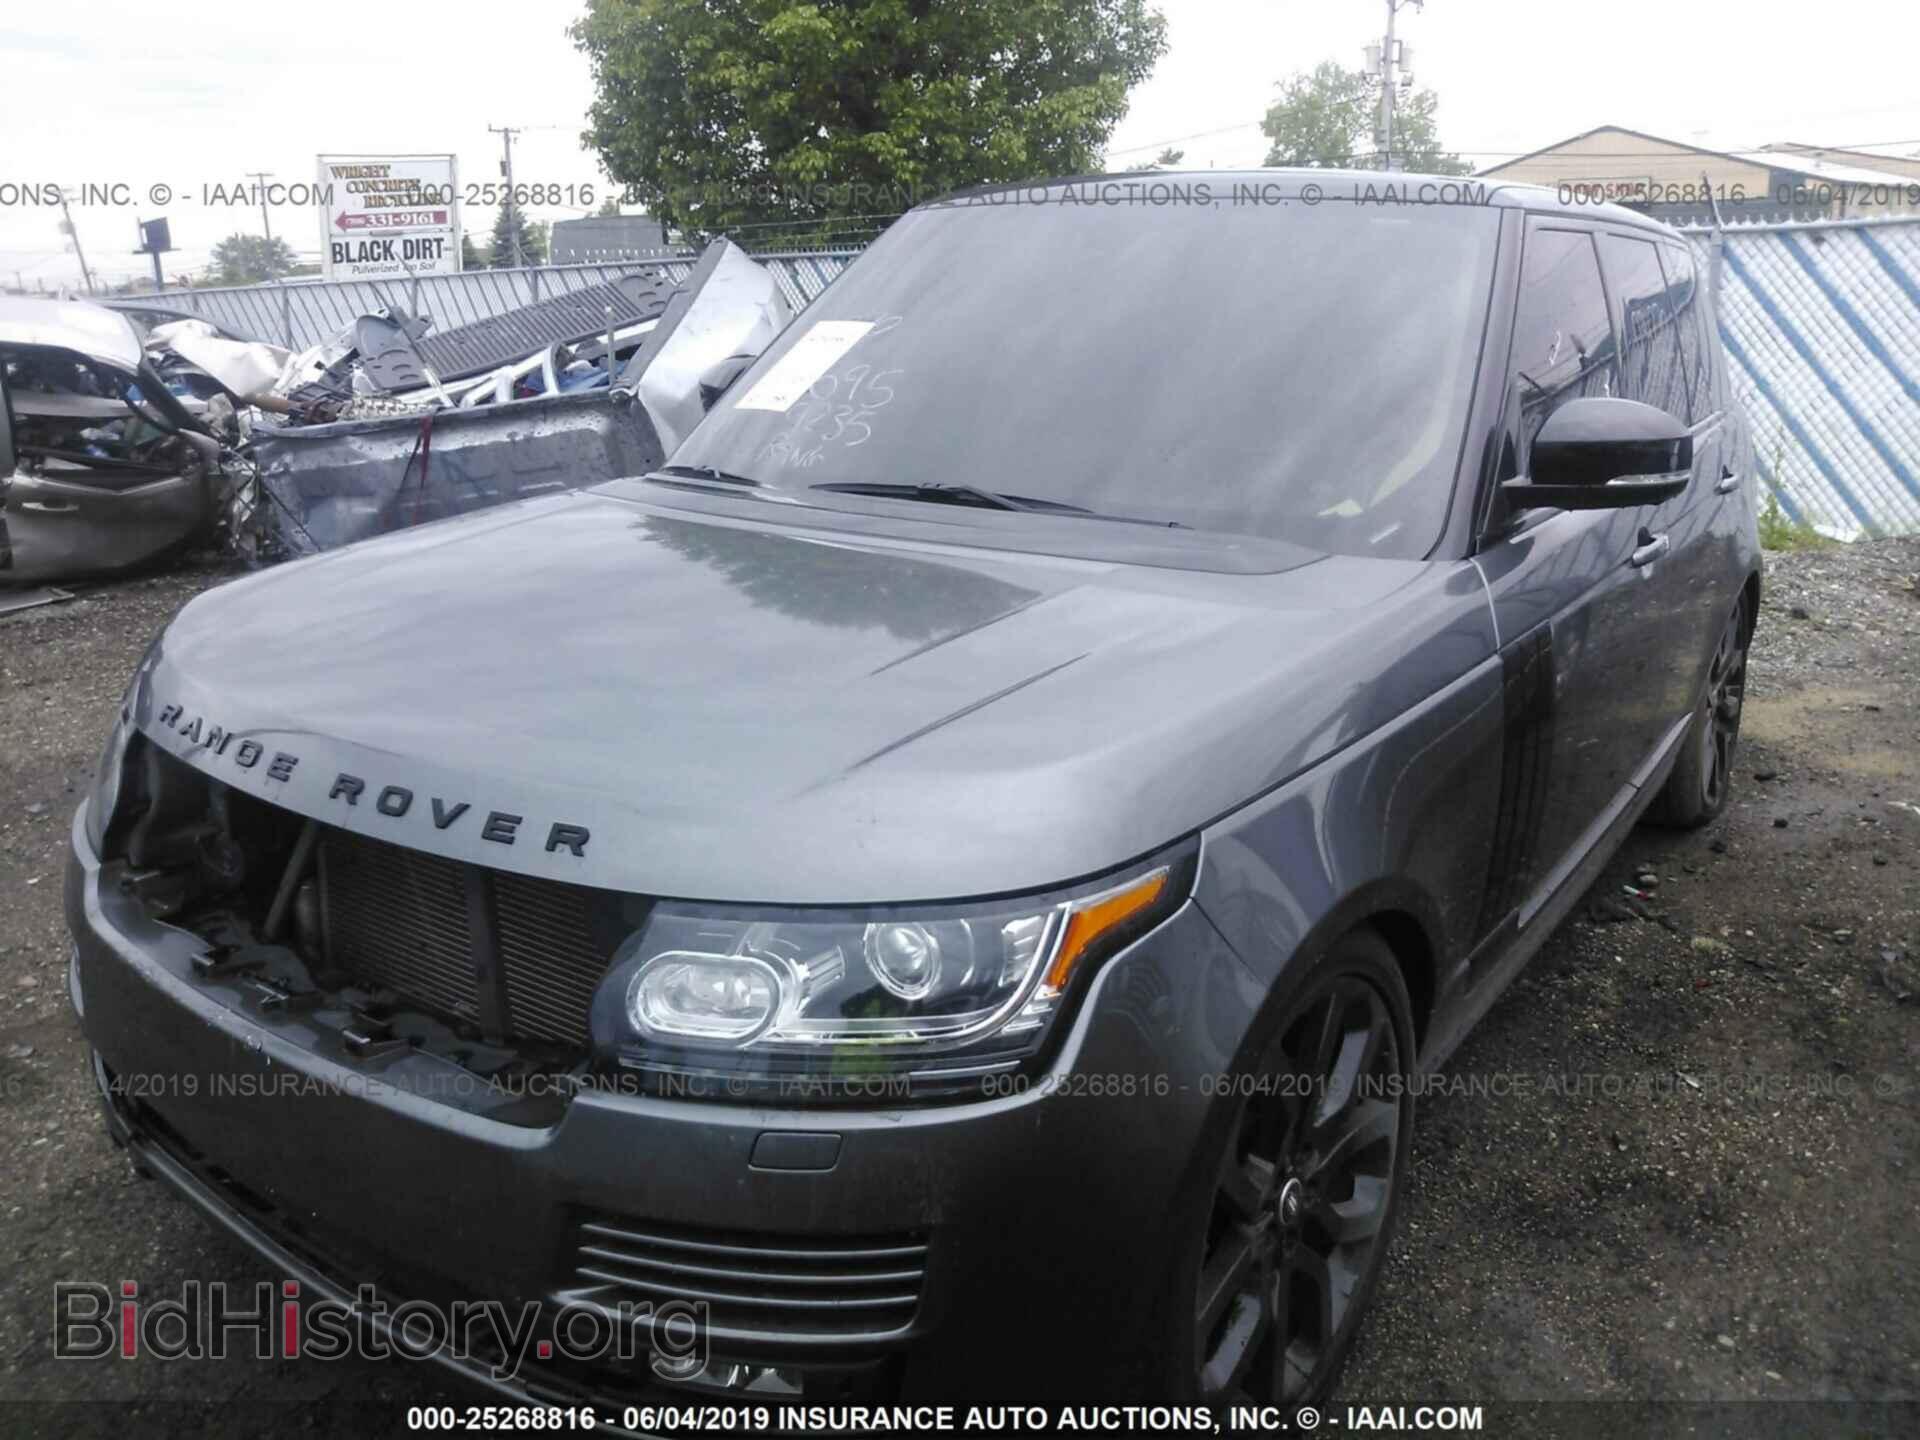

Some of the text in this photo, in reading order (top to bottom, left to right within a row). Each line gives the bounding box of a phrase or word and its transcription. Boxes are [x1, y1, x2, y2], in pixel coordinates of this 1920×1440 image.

[331, 237, 444, 264] BLACK DIRT
[158, 704, 591, 858] RANGE ROVER
